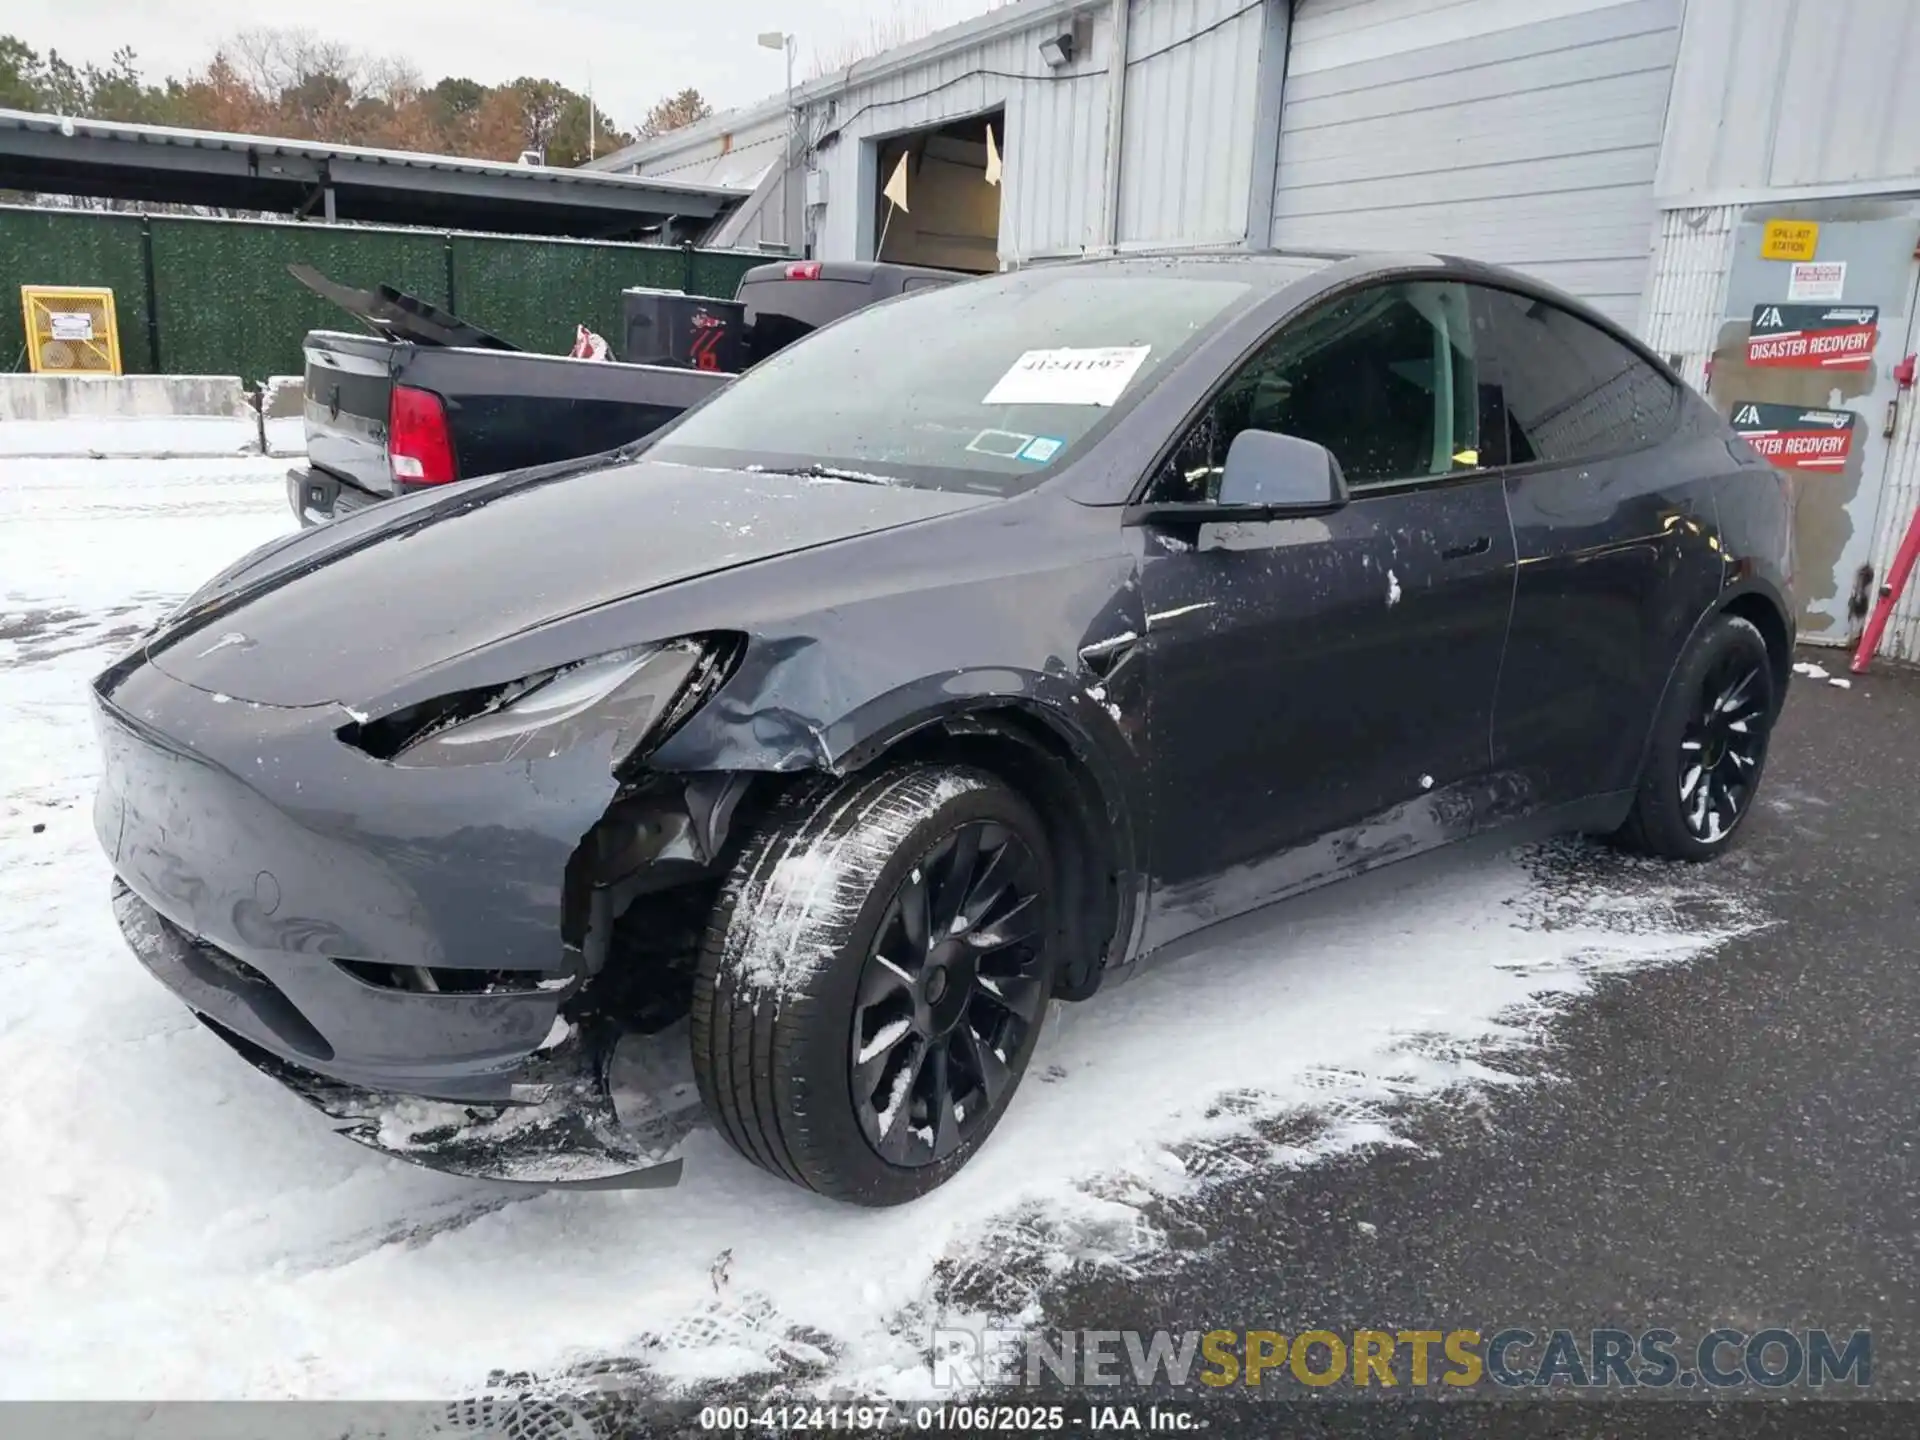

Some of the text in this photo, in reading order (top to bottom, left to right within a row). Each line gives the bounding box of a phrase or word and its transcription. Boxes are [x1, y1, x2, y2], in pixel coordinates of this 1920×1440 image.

[1750, 332, 1871, 360] DISASTER RECOVERY
[1785, 436, 1846, 454] RECOVERY
